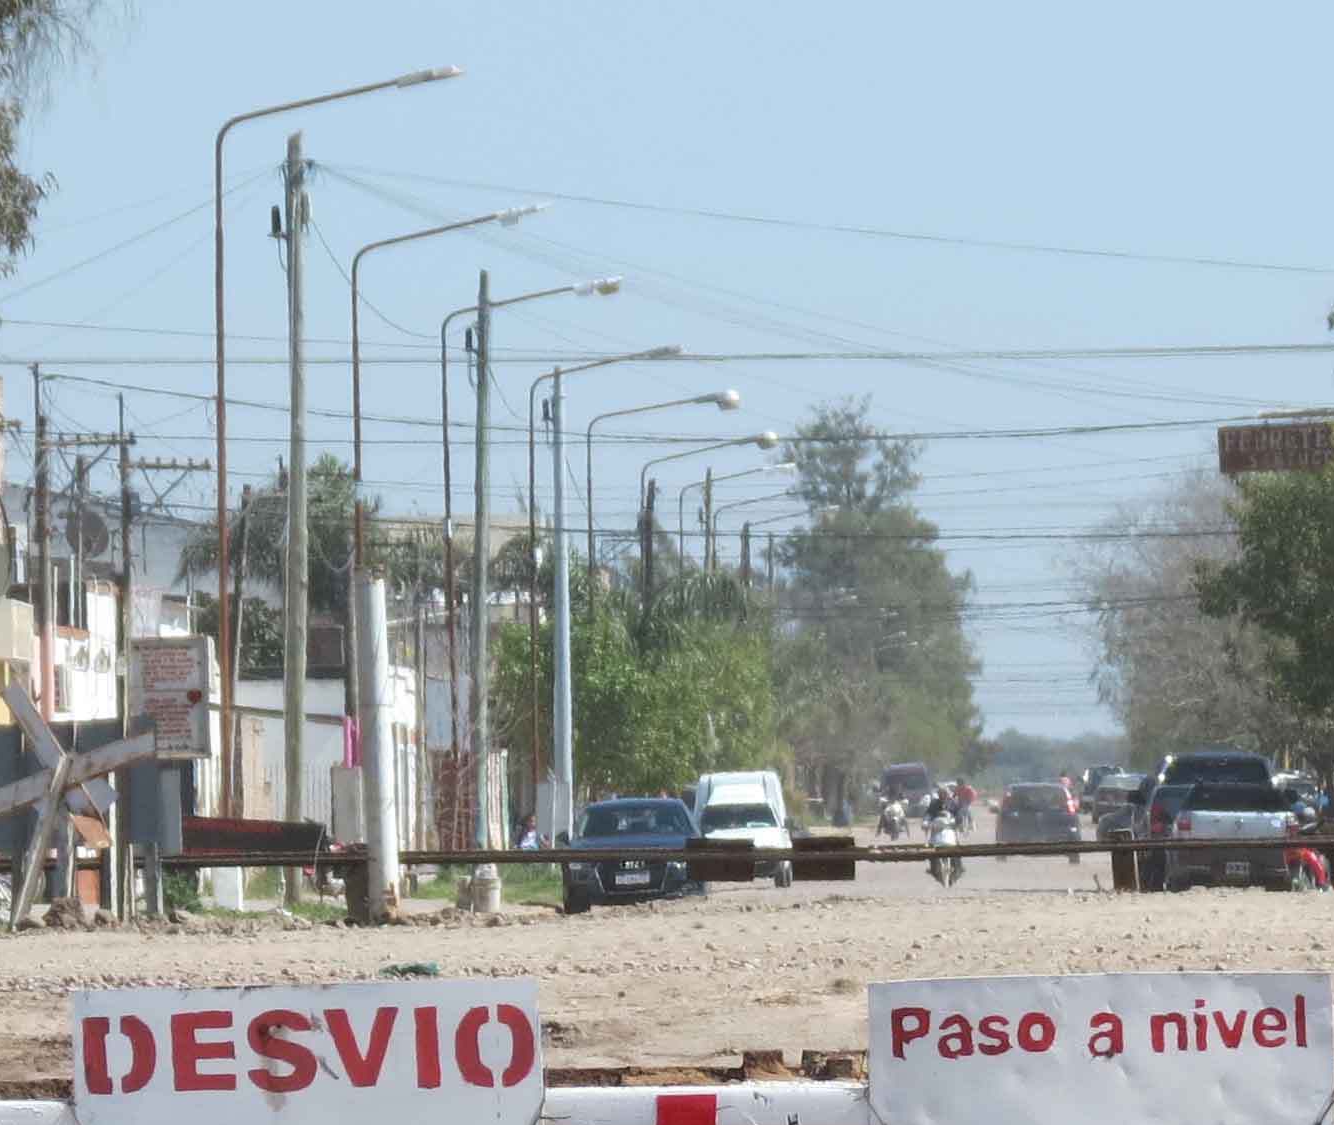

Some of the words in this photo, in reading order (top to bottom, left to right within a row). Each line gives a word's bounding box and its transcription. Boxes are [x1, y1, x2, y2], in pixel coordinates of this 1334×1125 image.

[82, 1003, 535, 1094] DESVIO
[891, 1007, 1057, 1060] Paso
[1088, 1012, 1124, 1058] a
[1150, 994, 1308, 1054] nivel
